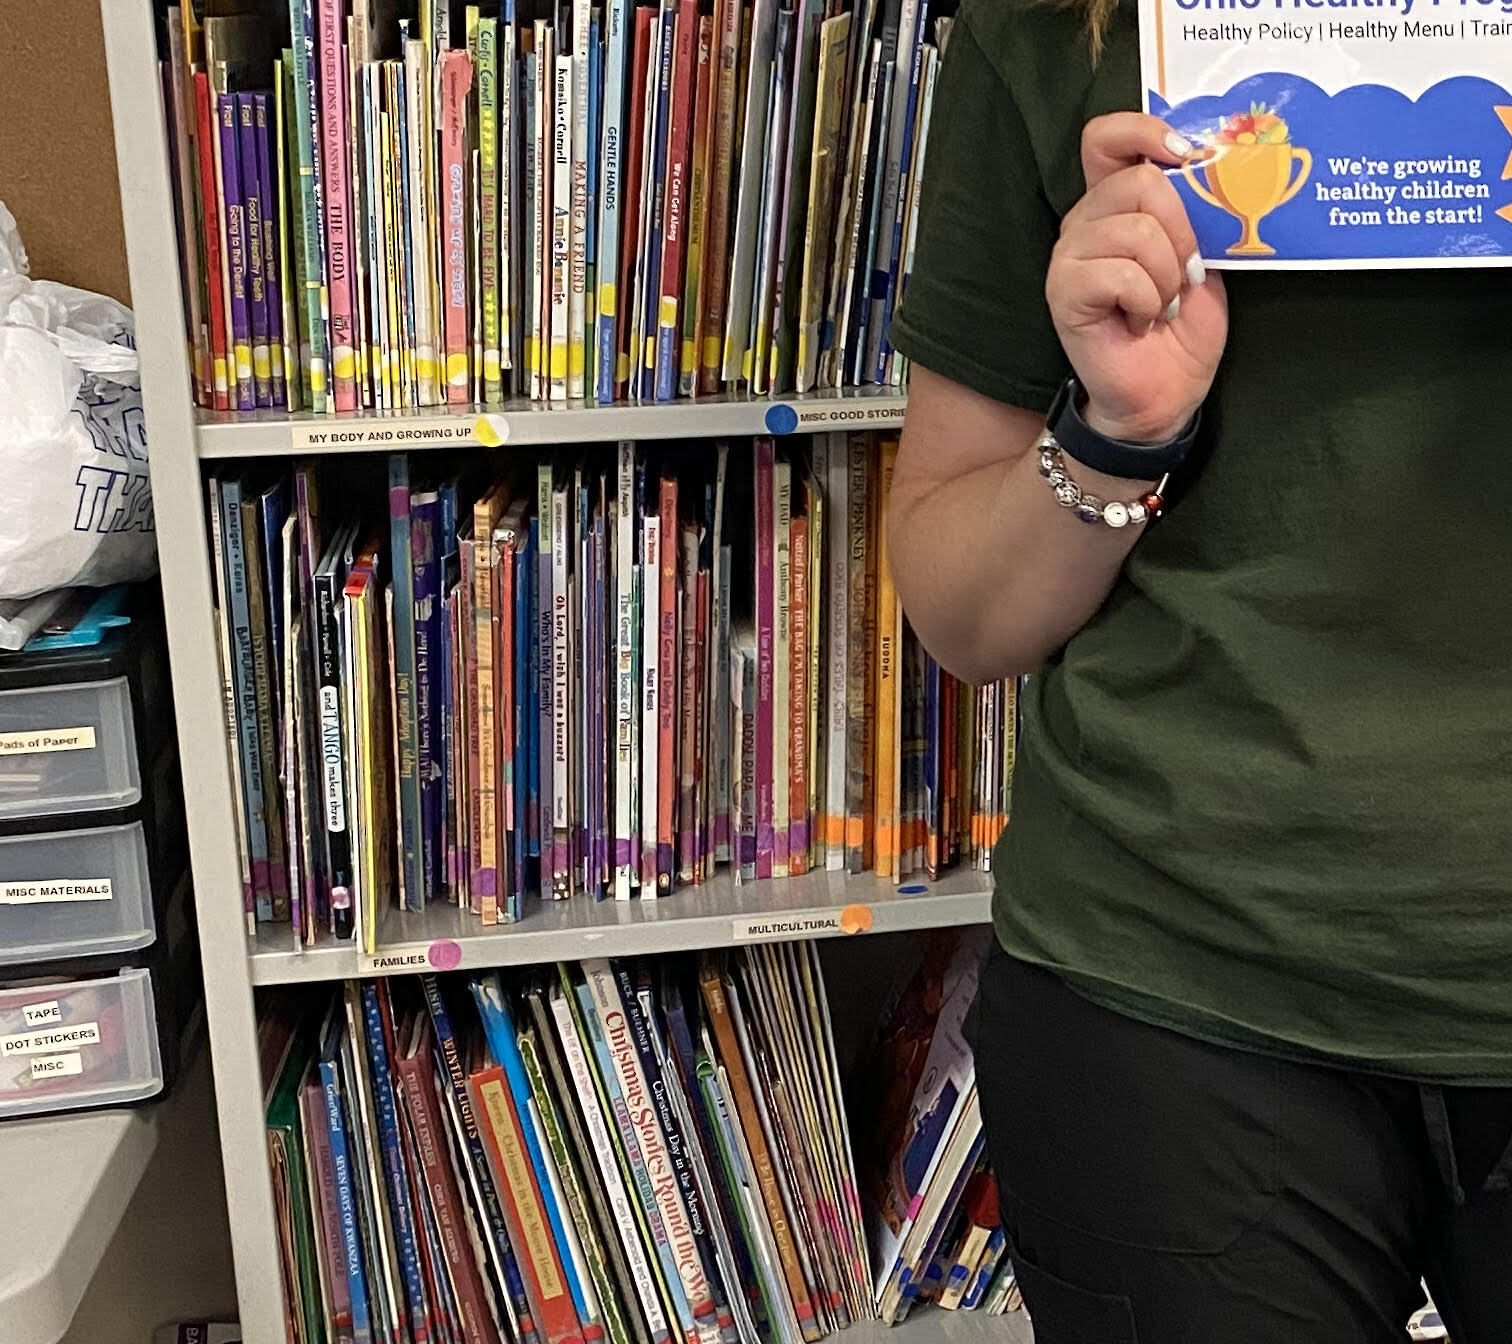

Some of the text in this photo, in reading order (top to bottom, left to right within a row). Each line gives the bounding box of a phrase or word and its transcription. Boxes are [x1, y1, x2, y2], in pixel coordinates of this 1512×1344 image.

[1183, 23, 1252, 42] Healthy
[1259, 22, 1313, 42] Policy
[1329, 21, 1397, 40] Healthy
[1404, 20, 1454, 37] Menu
[604, 126, 618, 211] GENTLE HANDS
[1329, 157, 1481, 179] We're growing
[1316, 182, 1489, 202] healthy children
[1330, 206, 1482, 226] from the start!
[572, 160, 588, 295] MAKING A FRIEND
[329, 206, 346, 283] THE BODY
[800, 409, 906, 423] MISC GOOD STORIE
[309, 428, 472, 444] MY BODY AND GROWING UP
[74, 465, 155, 533] THA
[881, 636, 891, 680] BUDDHA
[28, 738, 39, 747] of
[43, 735, 78, 747] Paper
[321, 710, 340, 765] TANGO
[6, 885, 109, 897] MISC MATERIALS
[748, 918, 838, 935] MULTICULTURAL
[373, 955, 425, 968] FAMILIES
[27, 1006, 60, 1019] TAPE
[6, 1029, 95, 1050] DOT STICKERS
[34, 1061, 64, 1072] MISC
[604, 1010, 666, 1174] Christmas Stories
